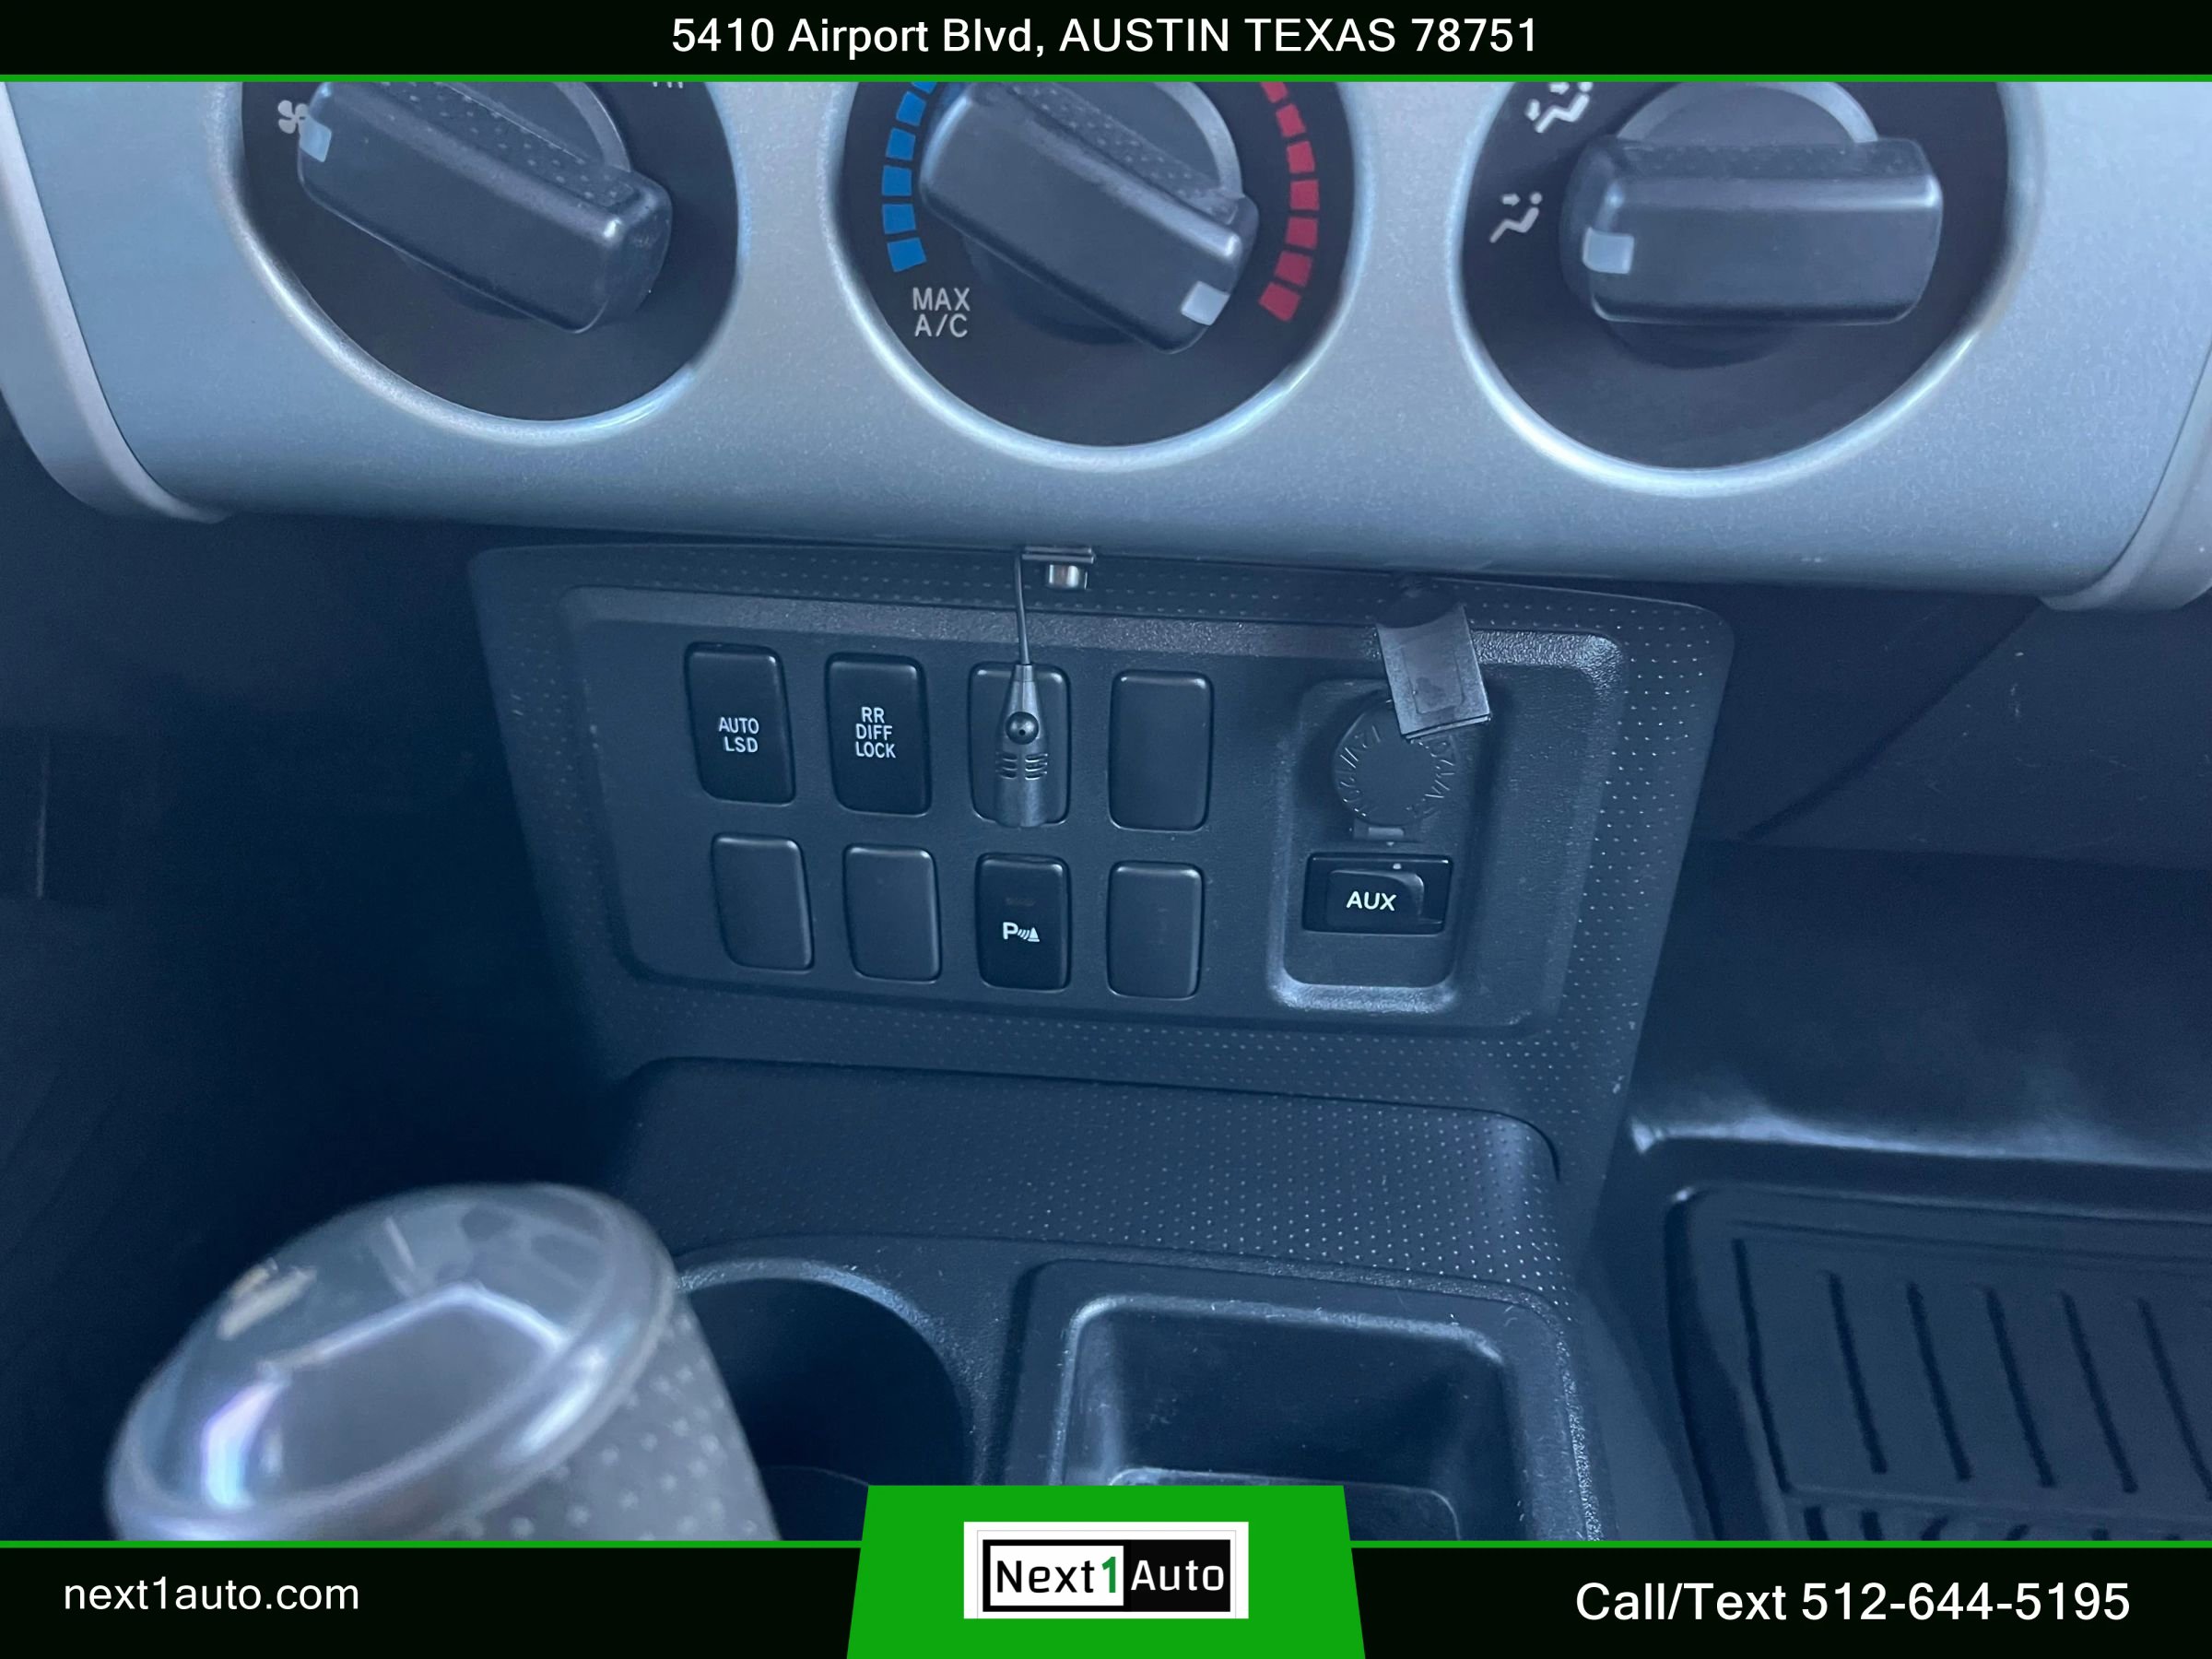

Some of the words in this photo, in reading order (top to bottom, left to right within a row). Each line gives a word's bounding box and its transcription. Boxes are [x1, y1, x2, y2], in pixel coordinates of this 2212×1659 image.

[912, 287, 971, 312] MAX
[914, 312, 970, 339] A/C
[861, 706, 886, 724] RR
[718, 716, 759, 735] AUTO
[855, 723, 893, 741] DIFF
[724, 735, 759, 754] LSD
[854, 740, 897, 759] LOCK
[1346, 890, 1397, 912] AUX
